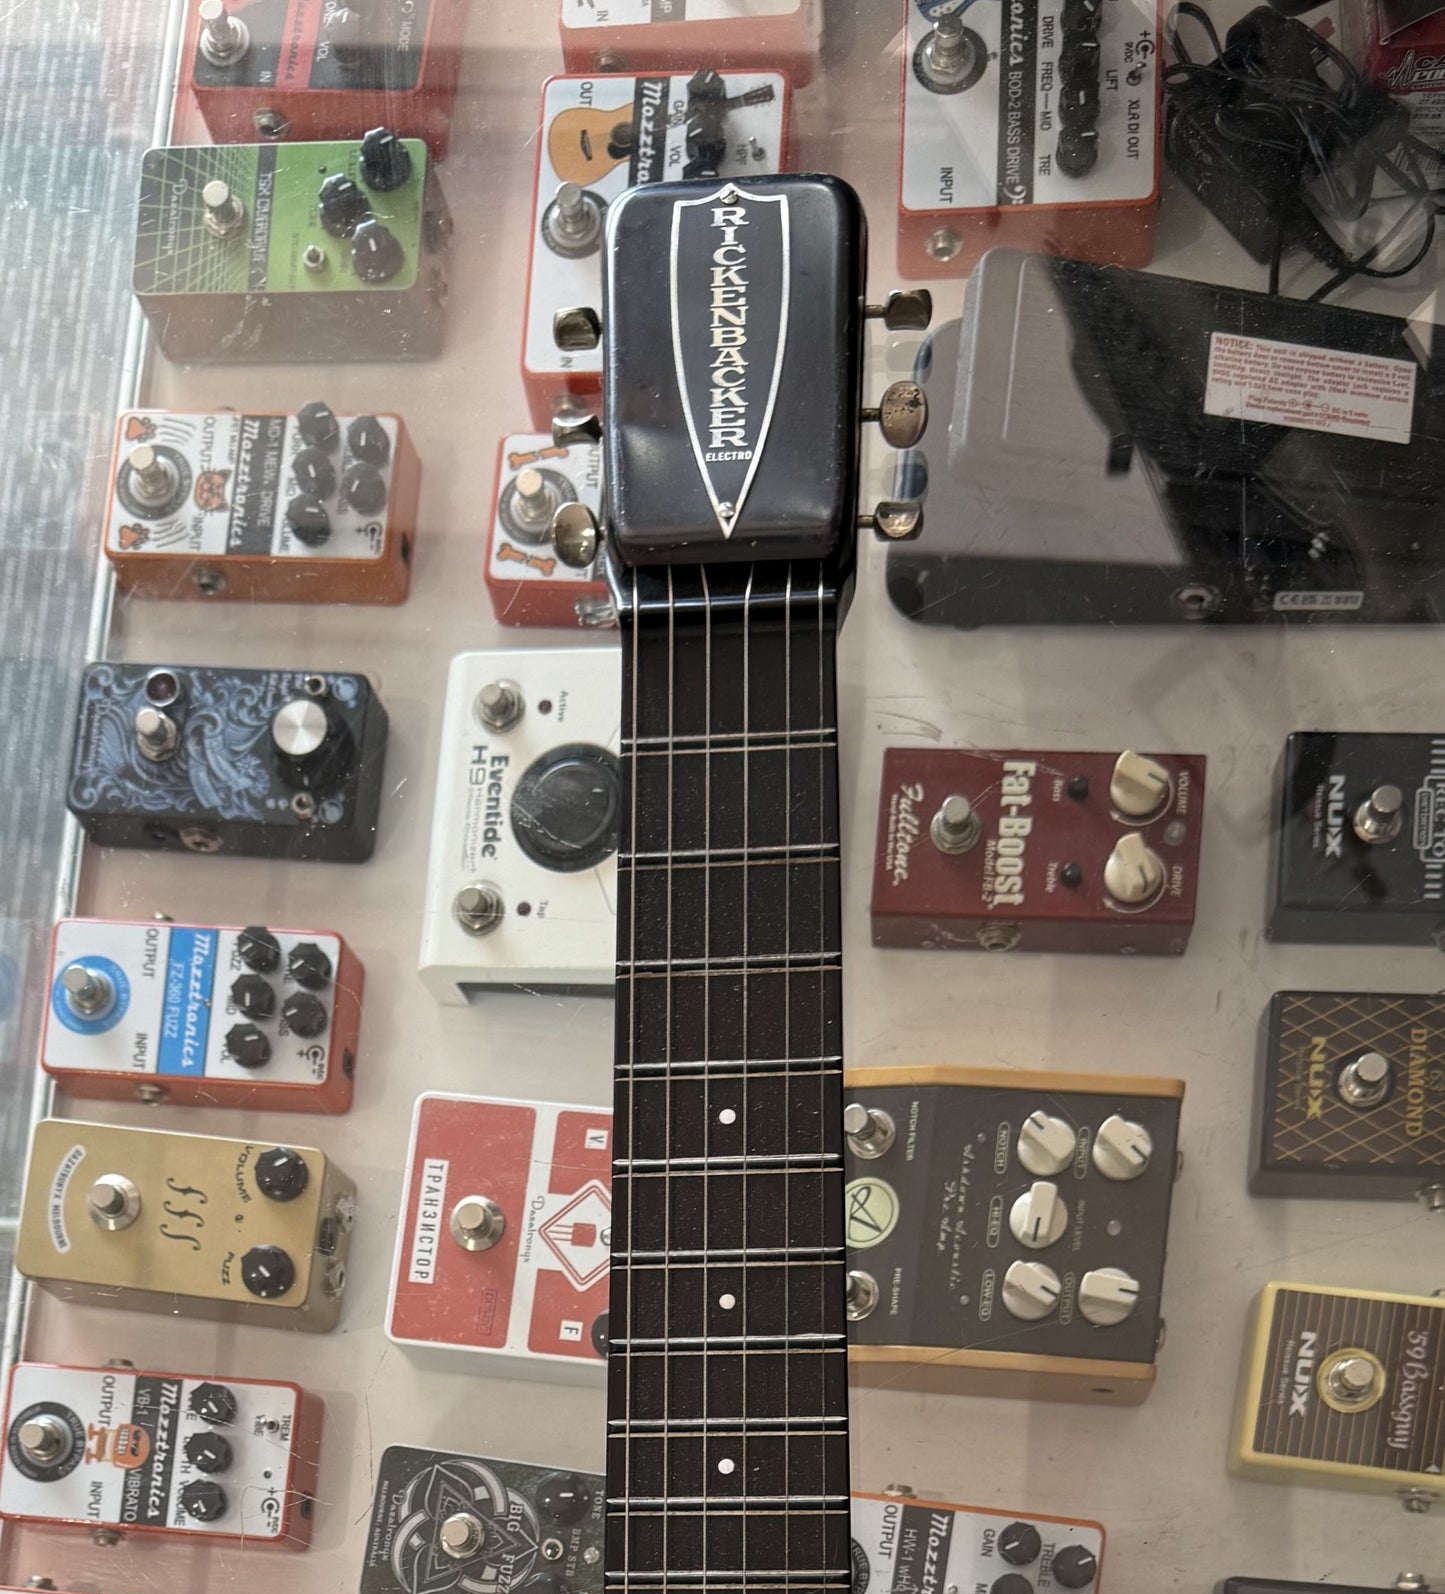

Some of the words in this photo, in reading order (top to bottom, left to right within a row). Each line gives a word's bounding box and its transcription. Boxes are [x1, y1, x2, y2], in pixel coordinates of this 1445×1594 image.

[596, 9, 608, 22] IN
[1042, 16, 1055, 48] DRIVE
[1008, 0, 1030, 67] onics
[316, 41, 331, 62] VOL
[260, 70, 272, 83] IN
[1007, 71, 1021, 109] BOD-2
[1041, 61, 1053, 91] FREQ
[1106, 69, 1118, 91] LIFT
[578, 81, 594, 107] OUT
[1128, 100, 1140, 121] XLR
[669, 100, 685, 127] GAIN
[1006, 112, 1019, 143] BASS
[1040, 111, 1052, 131] MID
[1128, 123, 1140, 134] DI
[668, 145, 683, 168] VOL
[1005, 147, 1018, 184] DRIVE
[1039, 154, 1052, 176] TRE
[1127, 139, 1139, 159] OUT
[940, 167, 954, 204] INPUT
[709, 207, 750, 448] RICKENBACKER
[561, 356, 573, 369] IN
[199, 416, 217, 464] OUTPUT
[266, 418, 282, 448] MD-1
[705, 451, 752, 461] ELECTRO
[230, 418, 261, 548] Mozztronics
[258, 490, 273, 527] DRIVE
[189, 516, 204, 552] INPUT
[557, 691, 569, 722] Active
[468, 744, 488, 785] H9
[480, 754, 510, 859] Eventide
[1176, 770, 1190, 815] VOLUME
[893, 783, 924, 882] Fulltone
[993, 761, 1037, 906] Fat-Boost
[1325, 774, 1346, 859] NUX
[1045, 862, 1058, 893] Treble
[1170, 865, 1183, 897] DRIVE
[536, 900, 549, 918] Tap
[142, 928, 161, 978] OUTPUT
[168, 962, 186, 1002] FZ-360
[182, 933, 212, 1068] Mozztronics
[164, 1006, 180, 1039] FUZZ
[133, 1032, 149, 1070] INPUT
[1305, 1036, 1327, 1120] NUX
[1404, 1028, 1428, 1137] DIAMOND
[907, 1101, 919, 1130] NOTCH
[905, 1132, 917, 1161] FILTER
[996, 1130, 1009, 1168] NOTCH
[1076, 1137, 1088, 1169] INPUT
[234, 1145, 255, 1203] VOLUME
[414, 1163, 445, 1279] ТРАНЗИСТОР
[988, 1206, 1001, 1235] HI-EQ
[221, 1251, 236, 1286] FUZZ
[889, 1268, 903, 1315] PRE-SHAPE
[981, 1273, 994, 1316] LOW-EQ
[1061, 1277, 1074, 1319] OUTPUT
[564, 1326, 579, 1336] F
[1281, 1340, 1296, 1375] Reissue
[1289, 1330, 1318, 1417] NUX
[98, 1375, 117, 1427] OUTPUT
[135, 1388, 152, 1416] VB-1
[279, 1415, 292, 1441] TREM
[146, 1382, 178, 1519] Mozztronics
[87, 1481, 104, 1519] INPUT
[124, 1468, 143, 1522] VIBRATO
[591, 1490, 605, 1520] TONE
[506, 1503, 523, 1532] BIG
[878, 1504, 899, 1559] OUTPUT
[980, 1528, 996, 1557] GAIN
[496, 1553, 515, 1594] FUZZ
[1037, 1543, 1056, 1587] TREBLE
